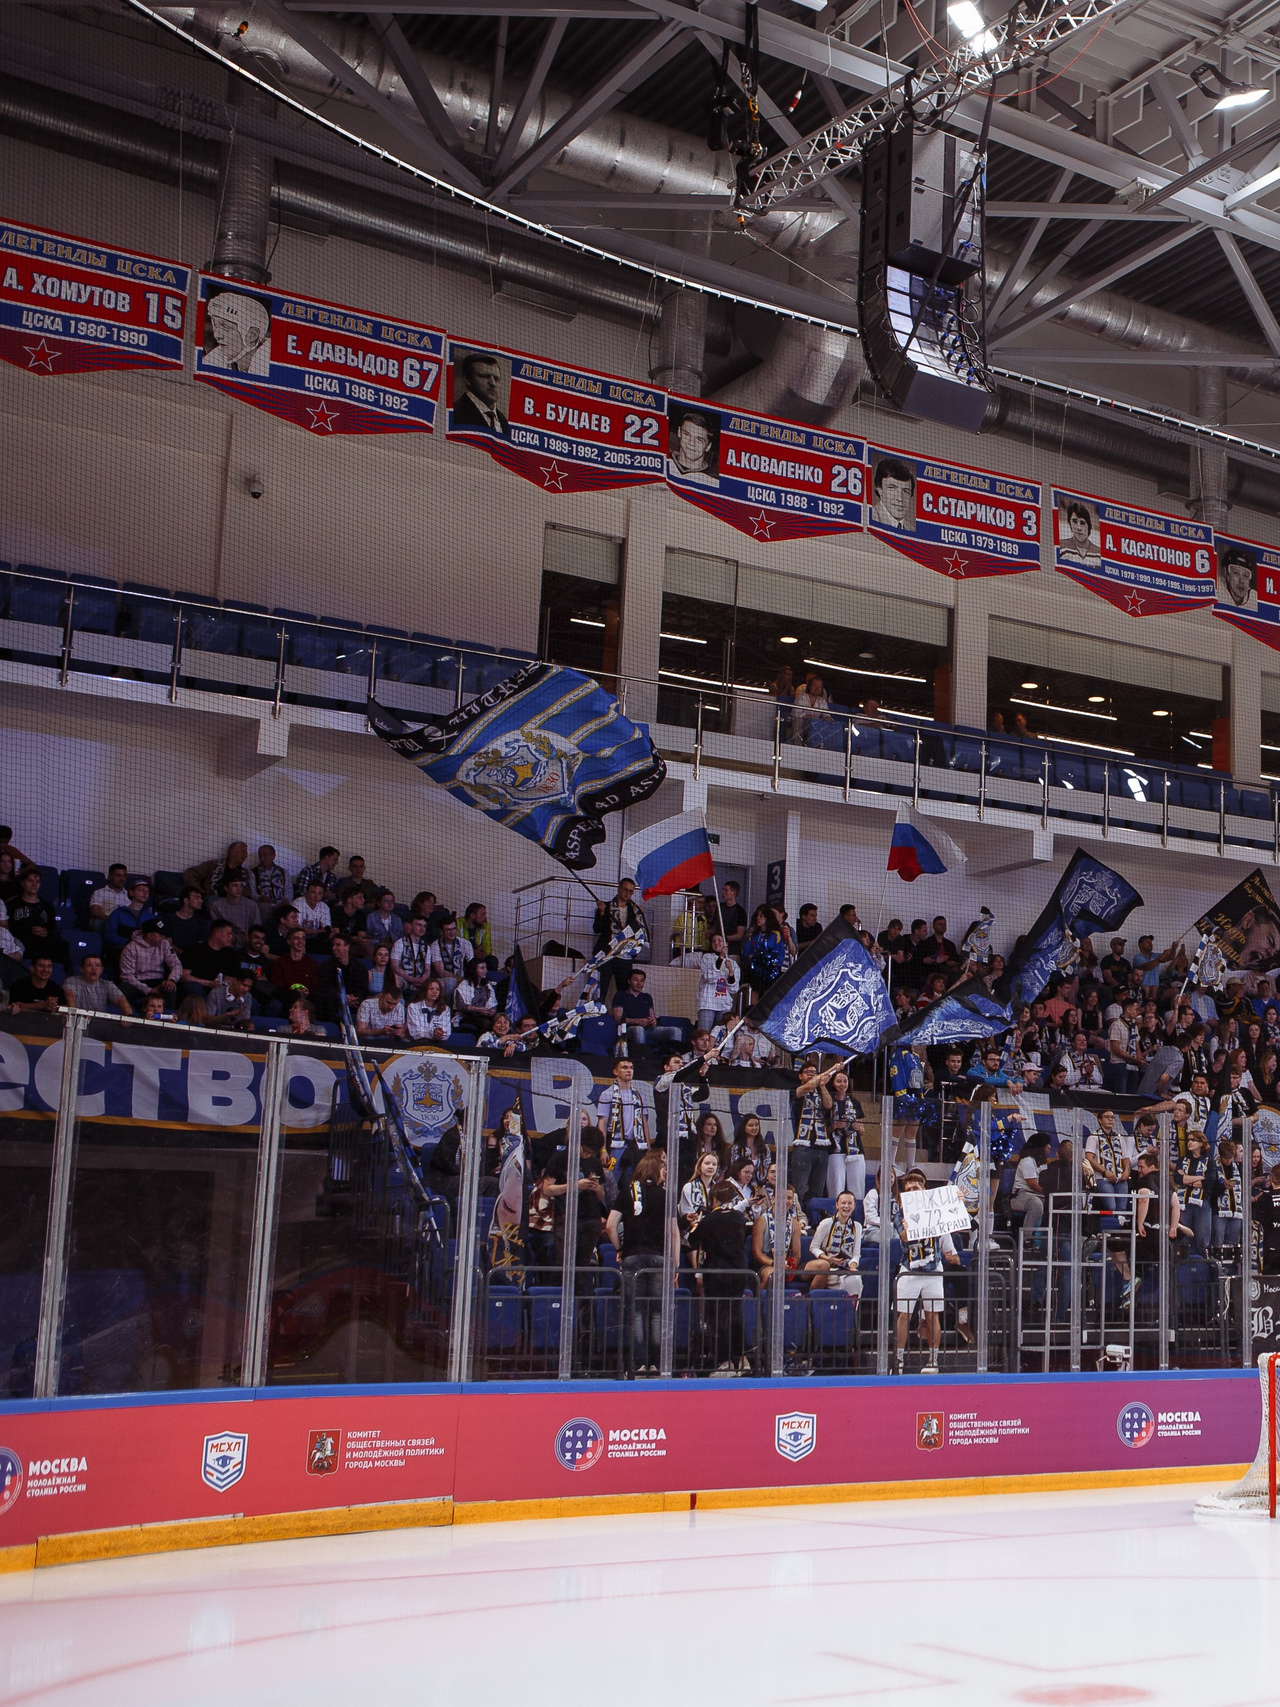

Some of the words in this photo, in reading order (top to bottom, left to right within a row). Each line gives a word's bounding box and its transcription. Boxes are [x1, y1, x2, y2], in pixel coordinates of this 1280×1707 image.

[0, 230, 106, 269] ЛЕГЕНДЫ
[117, 259, 176, 284] ЦСКА
[3, 268, 24, 291] А.
[32, 273, 130, 313] ХОМУТОВ
[145, 292, 182, 330] 15
[22, 311, 63, 333] ЦСКА
[69, 320, 148, 347] 1980-1990
[281, 302, 373, 333] ЛЕГЕНДЫ
[382, 326, 432, 349] ЦСКА
[287, 335, 302, 355] Е.
[309, 340, 399, 378] ДАВЫДОВ
[402, 357, 440, 392] 67
[520, 364, 602, 394] ЛЕГЕНДЫ
[609, 385, 656, 406] ЦСКА
[304, 374, 339, 394] ЦСКА
[344, 384, 408, 412] 1986-1992
[524, 397, 541, 417] В.
[546, 403, 611, 434] БУЦАЕВ
[623, 414, 659, 446] 22
[730, 417, 806, 444] ЛЕГЕНДЫ
[812, 435, 857, 455] ЦСКА
[511, 428, 540, 447] ЦСКА
[543, 435, 601, 462] 1989-1992,
[604, 449, 661, 470] 2005-2006
[726, 449, 823, 485] А.КОВАЛЕНКО
[831, 465, 862, 495] 26
[923, 466, 990, 489] ЛЕГЕНДЫ
[996, 482, 1034, 499] ЦСКА
[747, 486, 776, 504] ЦСКА
[780, 492, 807, 510] 1988
[817, 499, 844, 516] 1992
[922, 493, 1015, 530] С.СТАРИКОВ
[1022, 510, 1037, 536] 3
[1104, 508, 1165, 531] ЛЕГЕНДЫ
[1170, 523, 1206, 539] ЦСКА
[941, 529, 967, 544] ЦСКА
[971, 534, 1018, 555] 1979-1989
[1105, 534, 1117, 552] А.
[1121, 538, 1191, 567] КАСАТОНОВ
[1105, 565, 1120, 575] ЦСКА
[1195, 549, 1210, 573] 6
[1266, 578, 1277, 595] И.
[771, 865, 781, 891] 3
[420, 1112, 440, 1122] 1830
[925, 1209, 943, 1227] 72
[782, 1421, 810, 1429] МСХЛ
[949, 1420, 998, 1428] ОБЩЕСТВЕННЫХ
[999, 1419, 1022, 1427] СВЯЗЕЙ
[1158, 1411, 1201, 1423] МОСКВА
[347, 1440, 406, 1449] ОБЩЕСТВЕННЫХ
[407, 1437, 435, 1446] СВЯЗЕЙ
[609, 1428, 666, 1441] МОСКВА
[998, 1427, 1029, 1435] ПОЛИТИКИ
[210, 1442, 241, 1453] МСХЛ
[352, 1449, 404, 1458] МОЛОДЁЖНОЙ
[406, 1448, 445, 1456] ПОЛИТИКИ
[608, 1442, 655, 1450] МОЛОДЁЖНАЯ
[28, 1457, 88, 1476] МОСКВА
[345, 1460, 373, 1468] ГОРОДА
[374, 1459, 405, 1467] МОСКВЫ
[26, 1486, 58, 1497] СТОЛИЦА
[60, 1484, 86, 1494] РОССИИ
[27, 1476, 76, 1488] МОЛОДЁЖНАЯ
